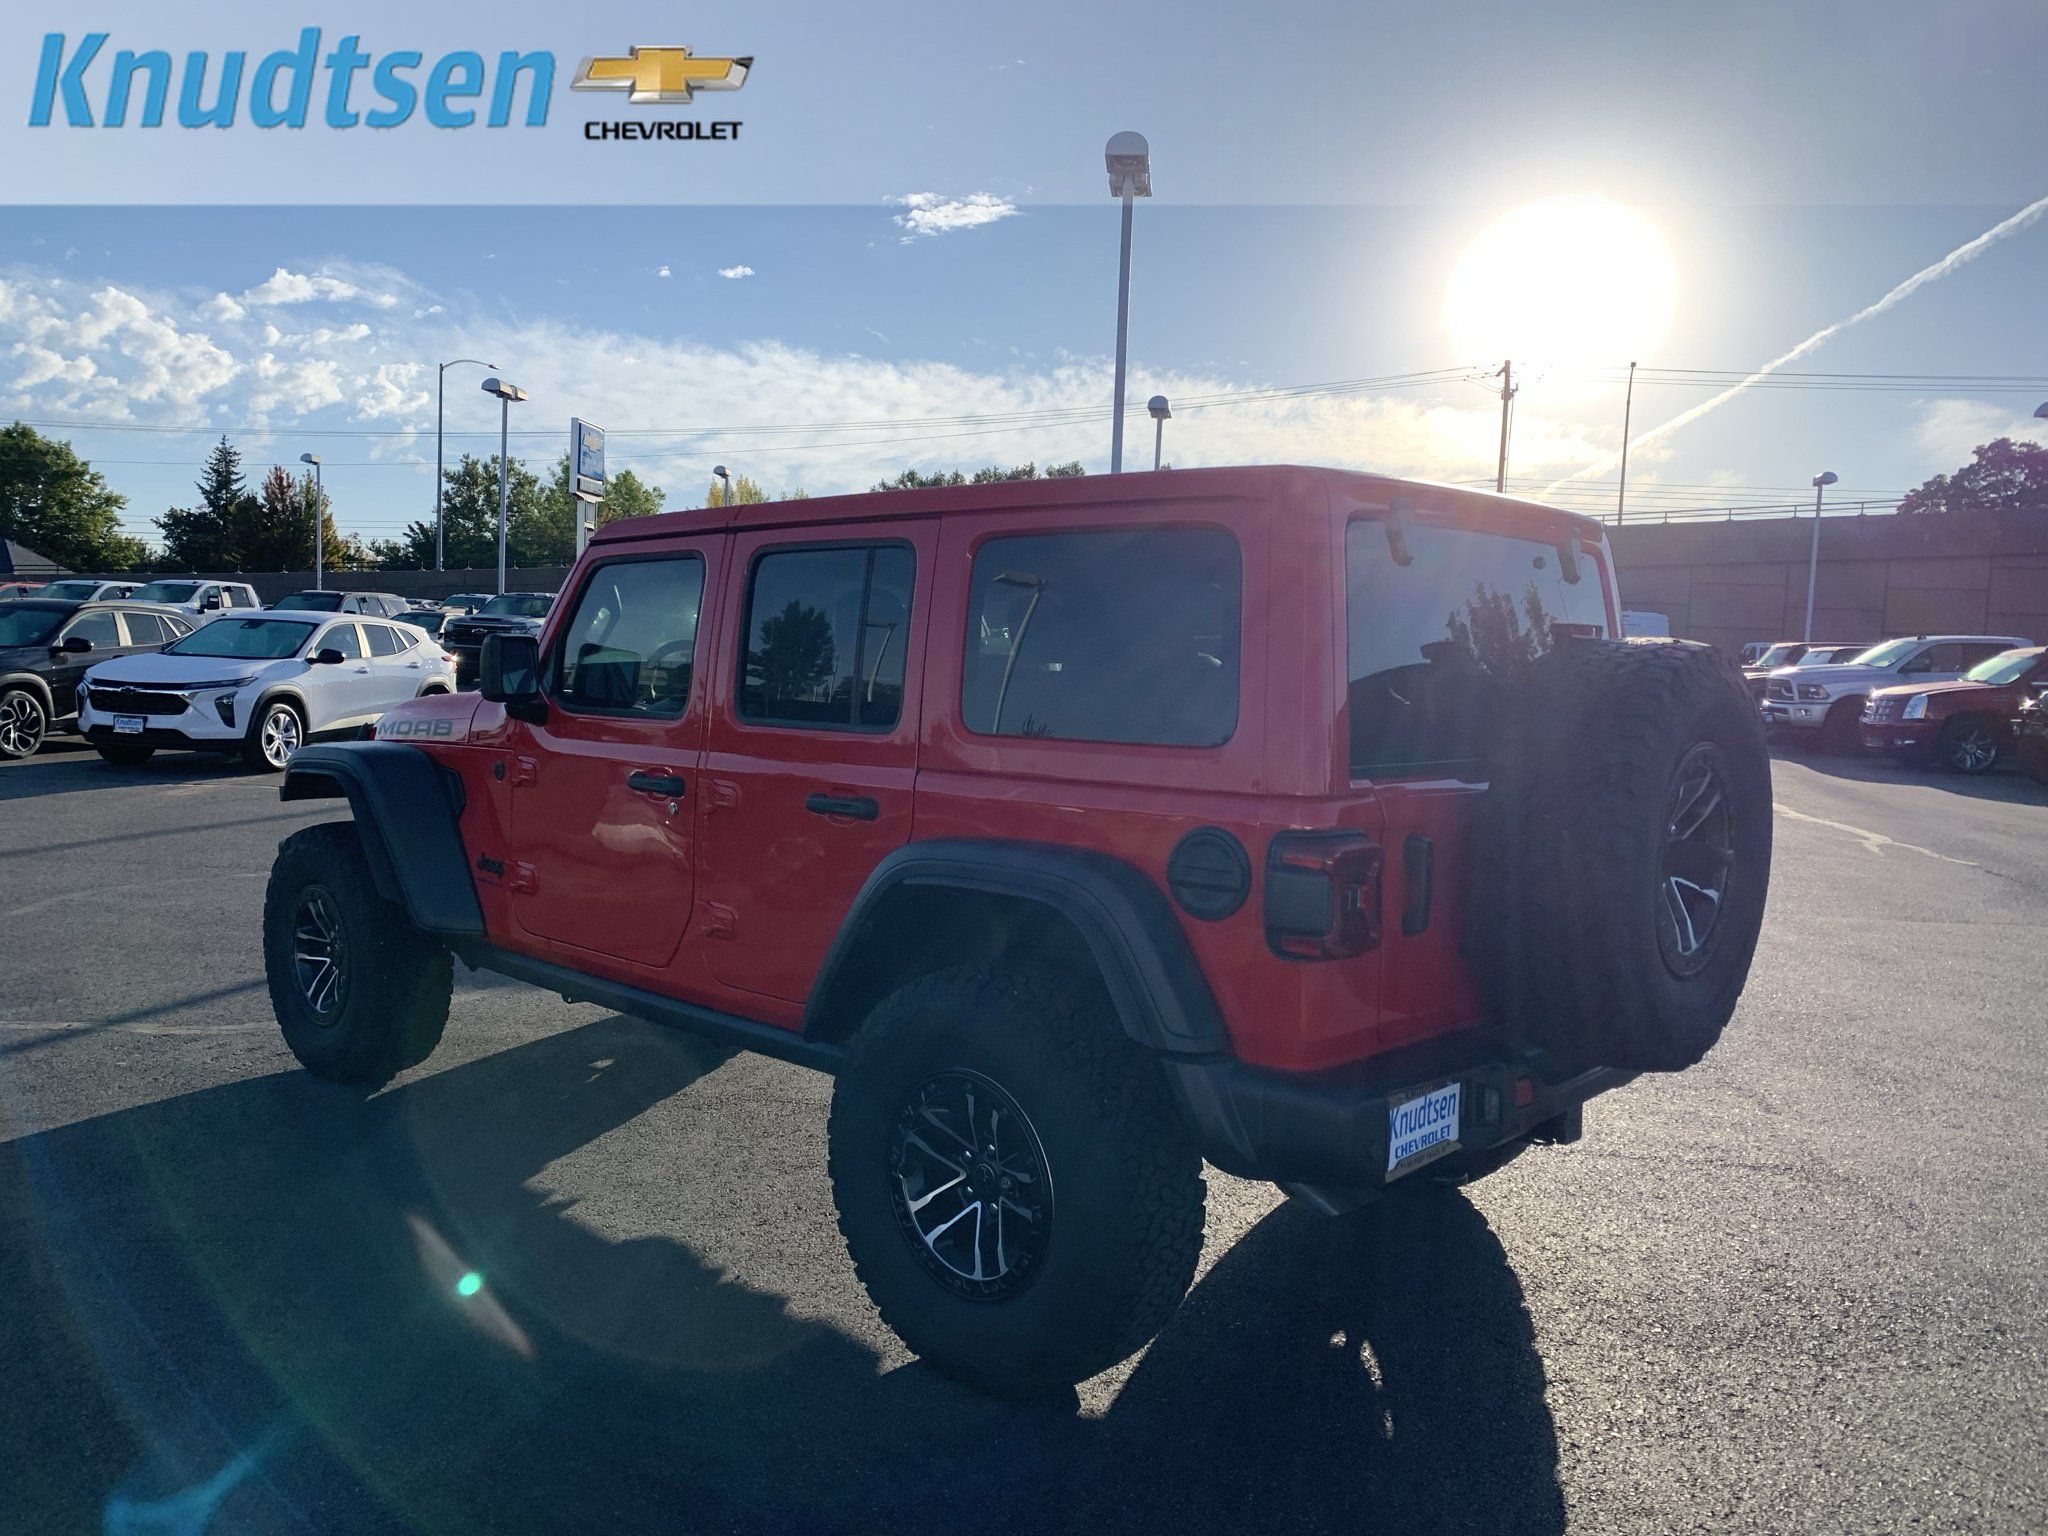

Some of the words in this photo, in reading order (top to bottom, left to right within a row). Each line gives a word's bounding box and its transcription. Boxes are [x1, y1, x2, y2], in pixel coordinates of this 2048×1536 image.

[378, 719, 453, 736] MOAB
[1390, 1092, 1457, 1141] Knudtsen
[1395, 1123, 1452, 1159] CHEVROLET
